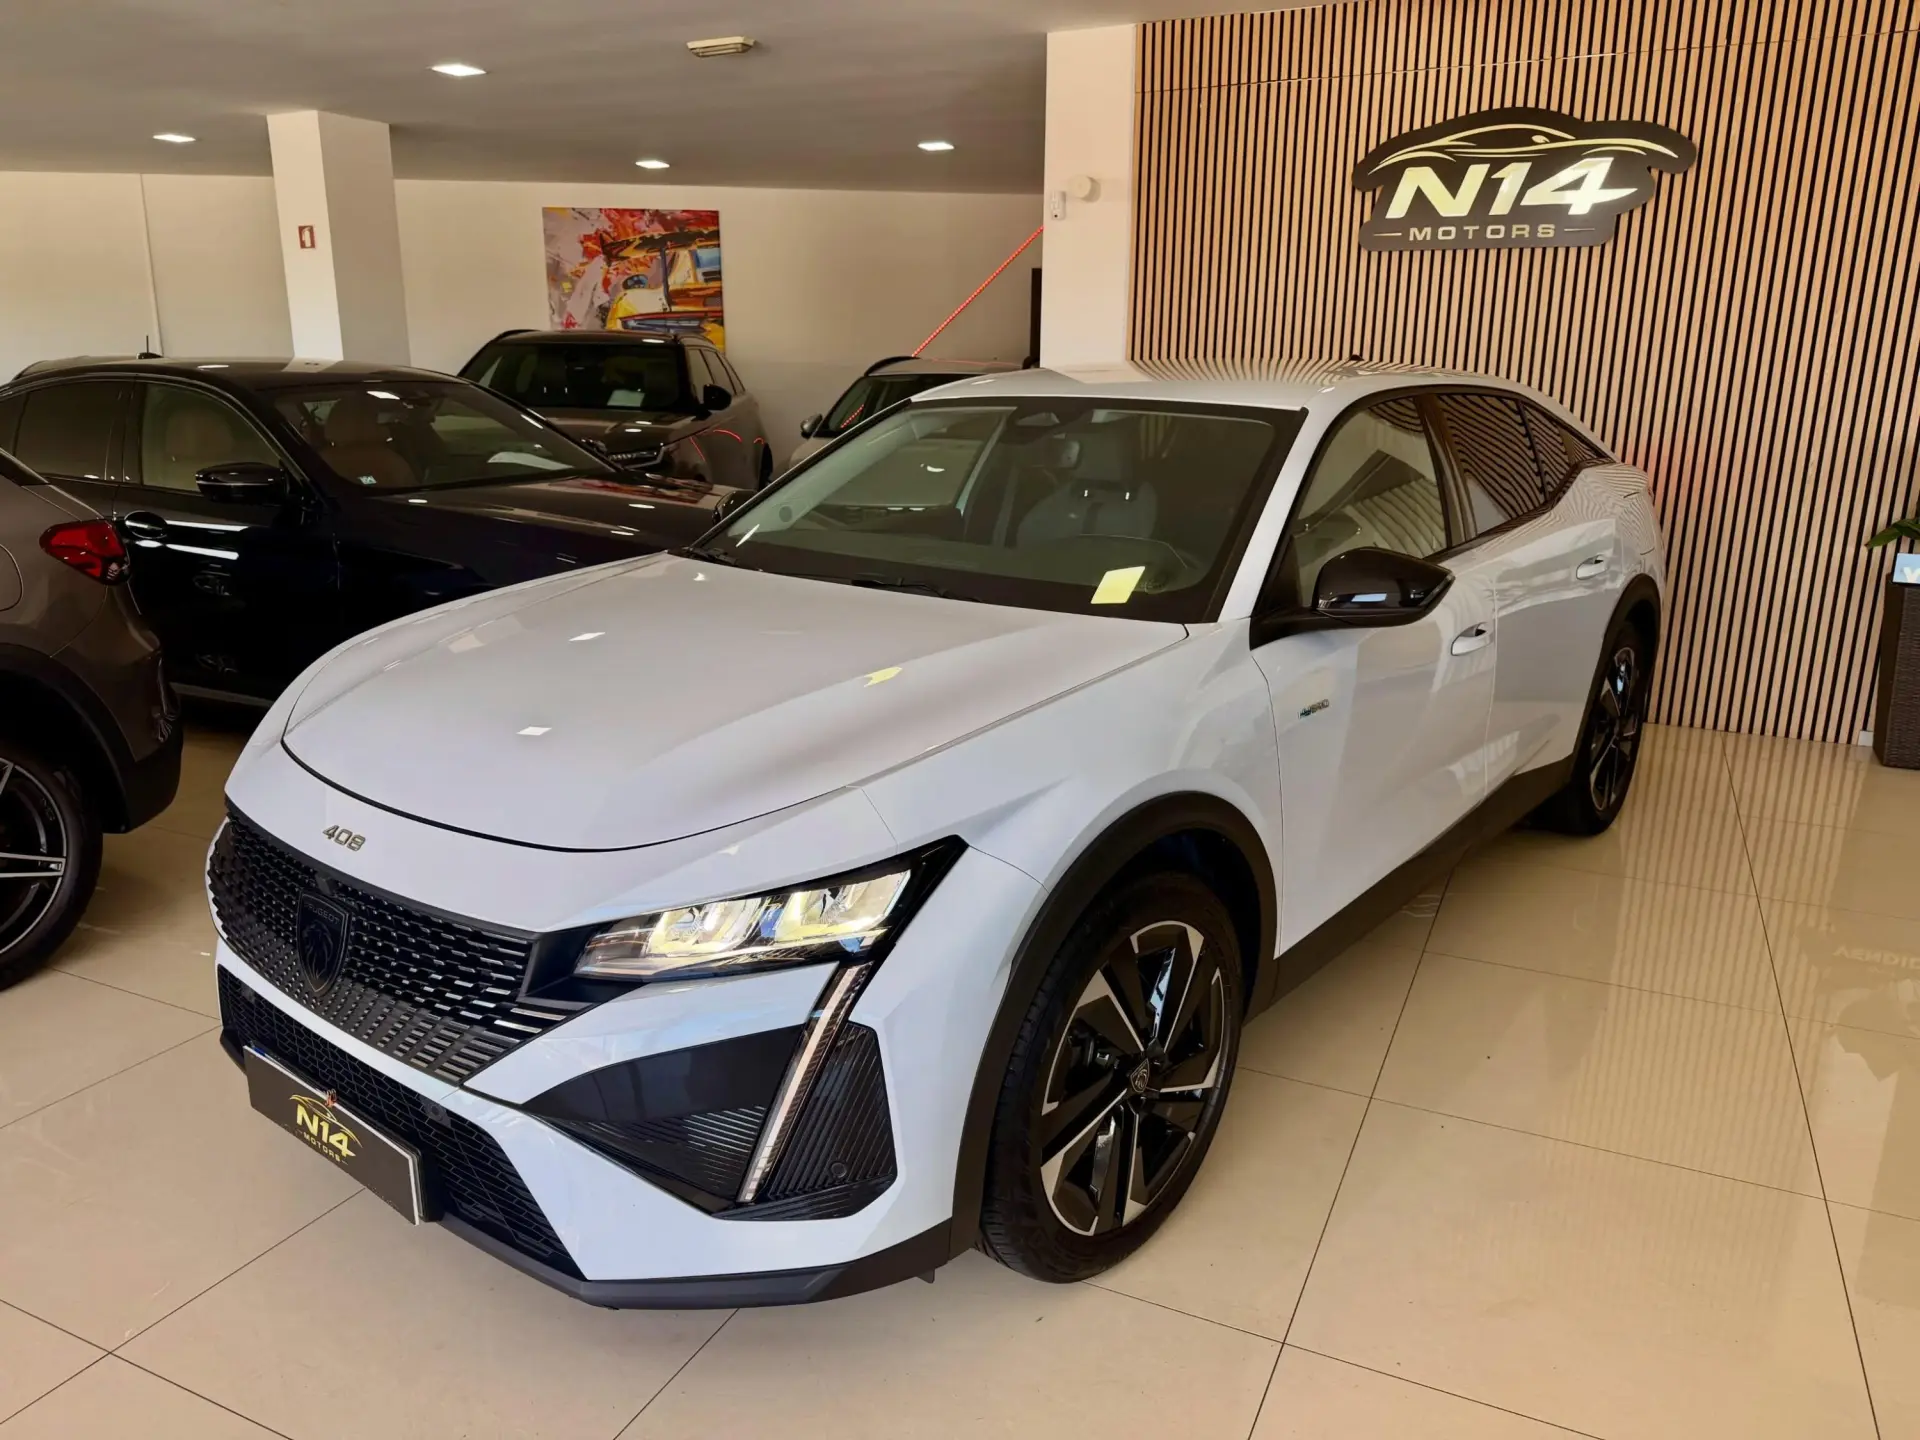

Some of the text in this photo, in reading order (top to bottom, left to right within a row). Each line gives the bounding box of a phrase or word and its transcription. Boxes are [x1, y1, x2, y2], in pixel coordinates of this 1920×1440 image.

[1385, 157, 1639, 220] N14
[1408, 223, 1556, 242] MOTORS
[322, 824, 366, 852] 408
[296, 1102, 357, 1158] N14
[304, 1133, 341, 1163] MOTORS
